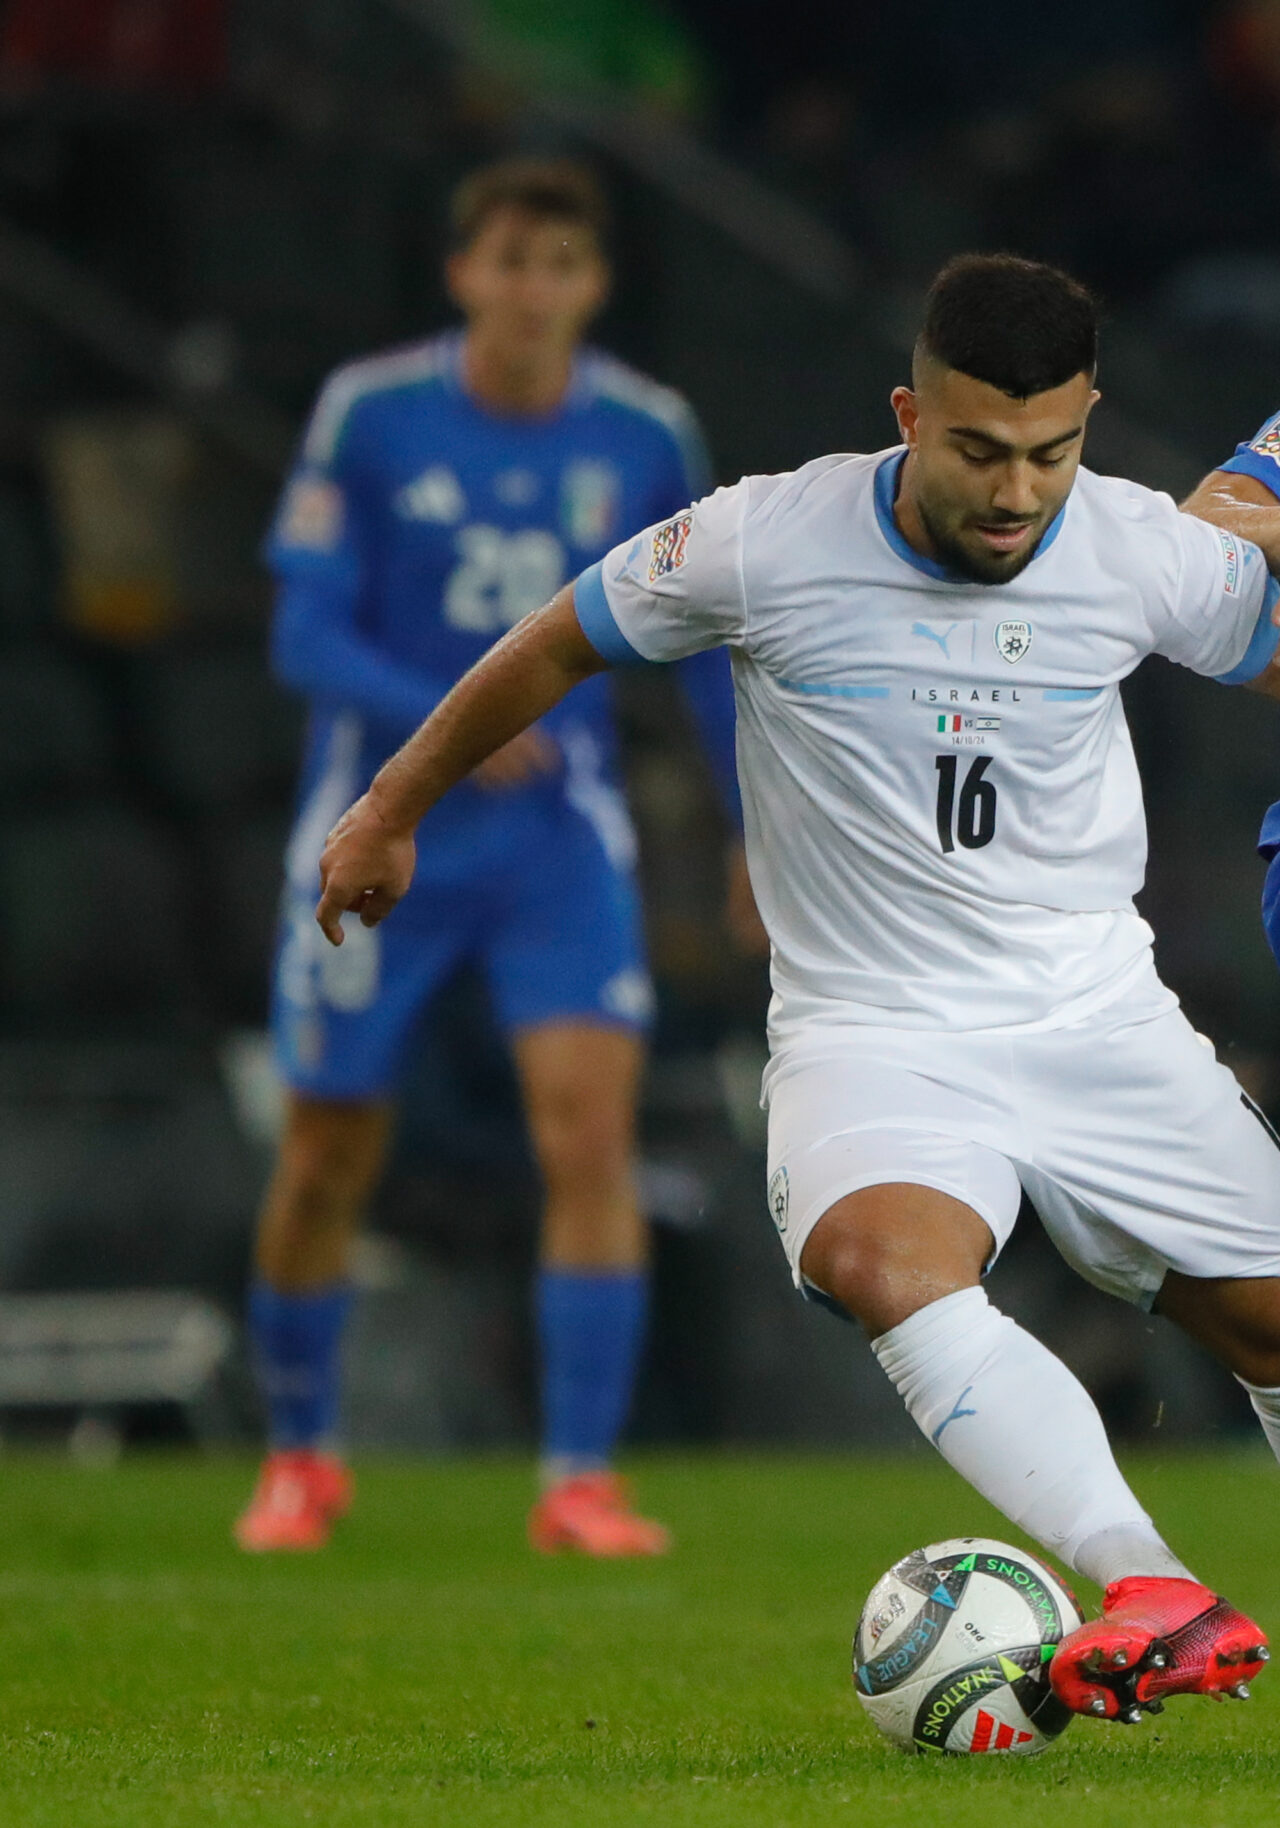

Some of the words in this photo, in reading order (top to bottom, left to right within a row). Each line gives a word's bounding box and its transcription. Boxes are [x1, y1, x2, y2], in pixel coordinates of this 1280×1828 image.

[912, 689, 1021, 702] ISRAEL
[951, 736, 985, 745] 14/10/24
[935, 755, 997, 854] 16
[986, 1558, 1057, 1628] NATIONS
[877, 1617, 938, 1682] LEAGUE
[964, 1622, 985, 1641] PRO
[922, 1668, 991, 1739] NATIONS
